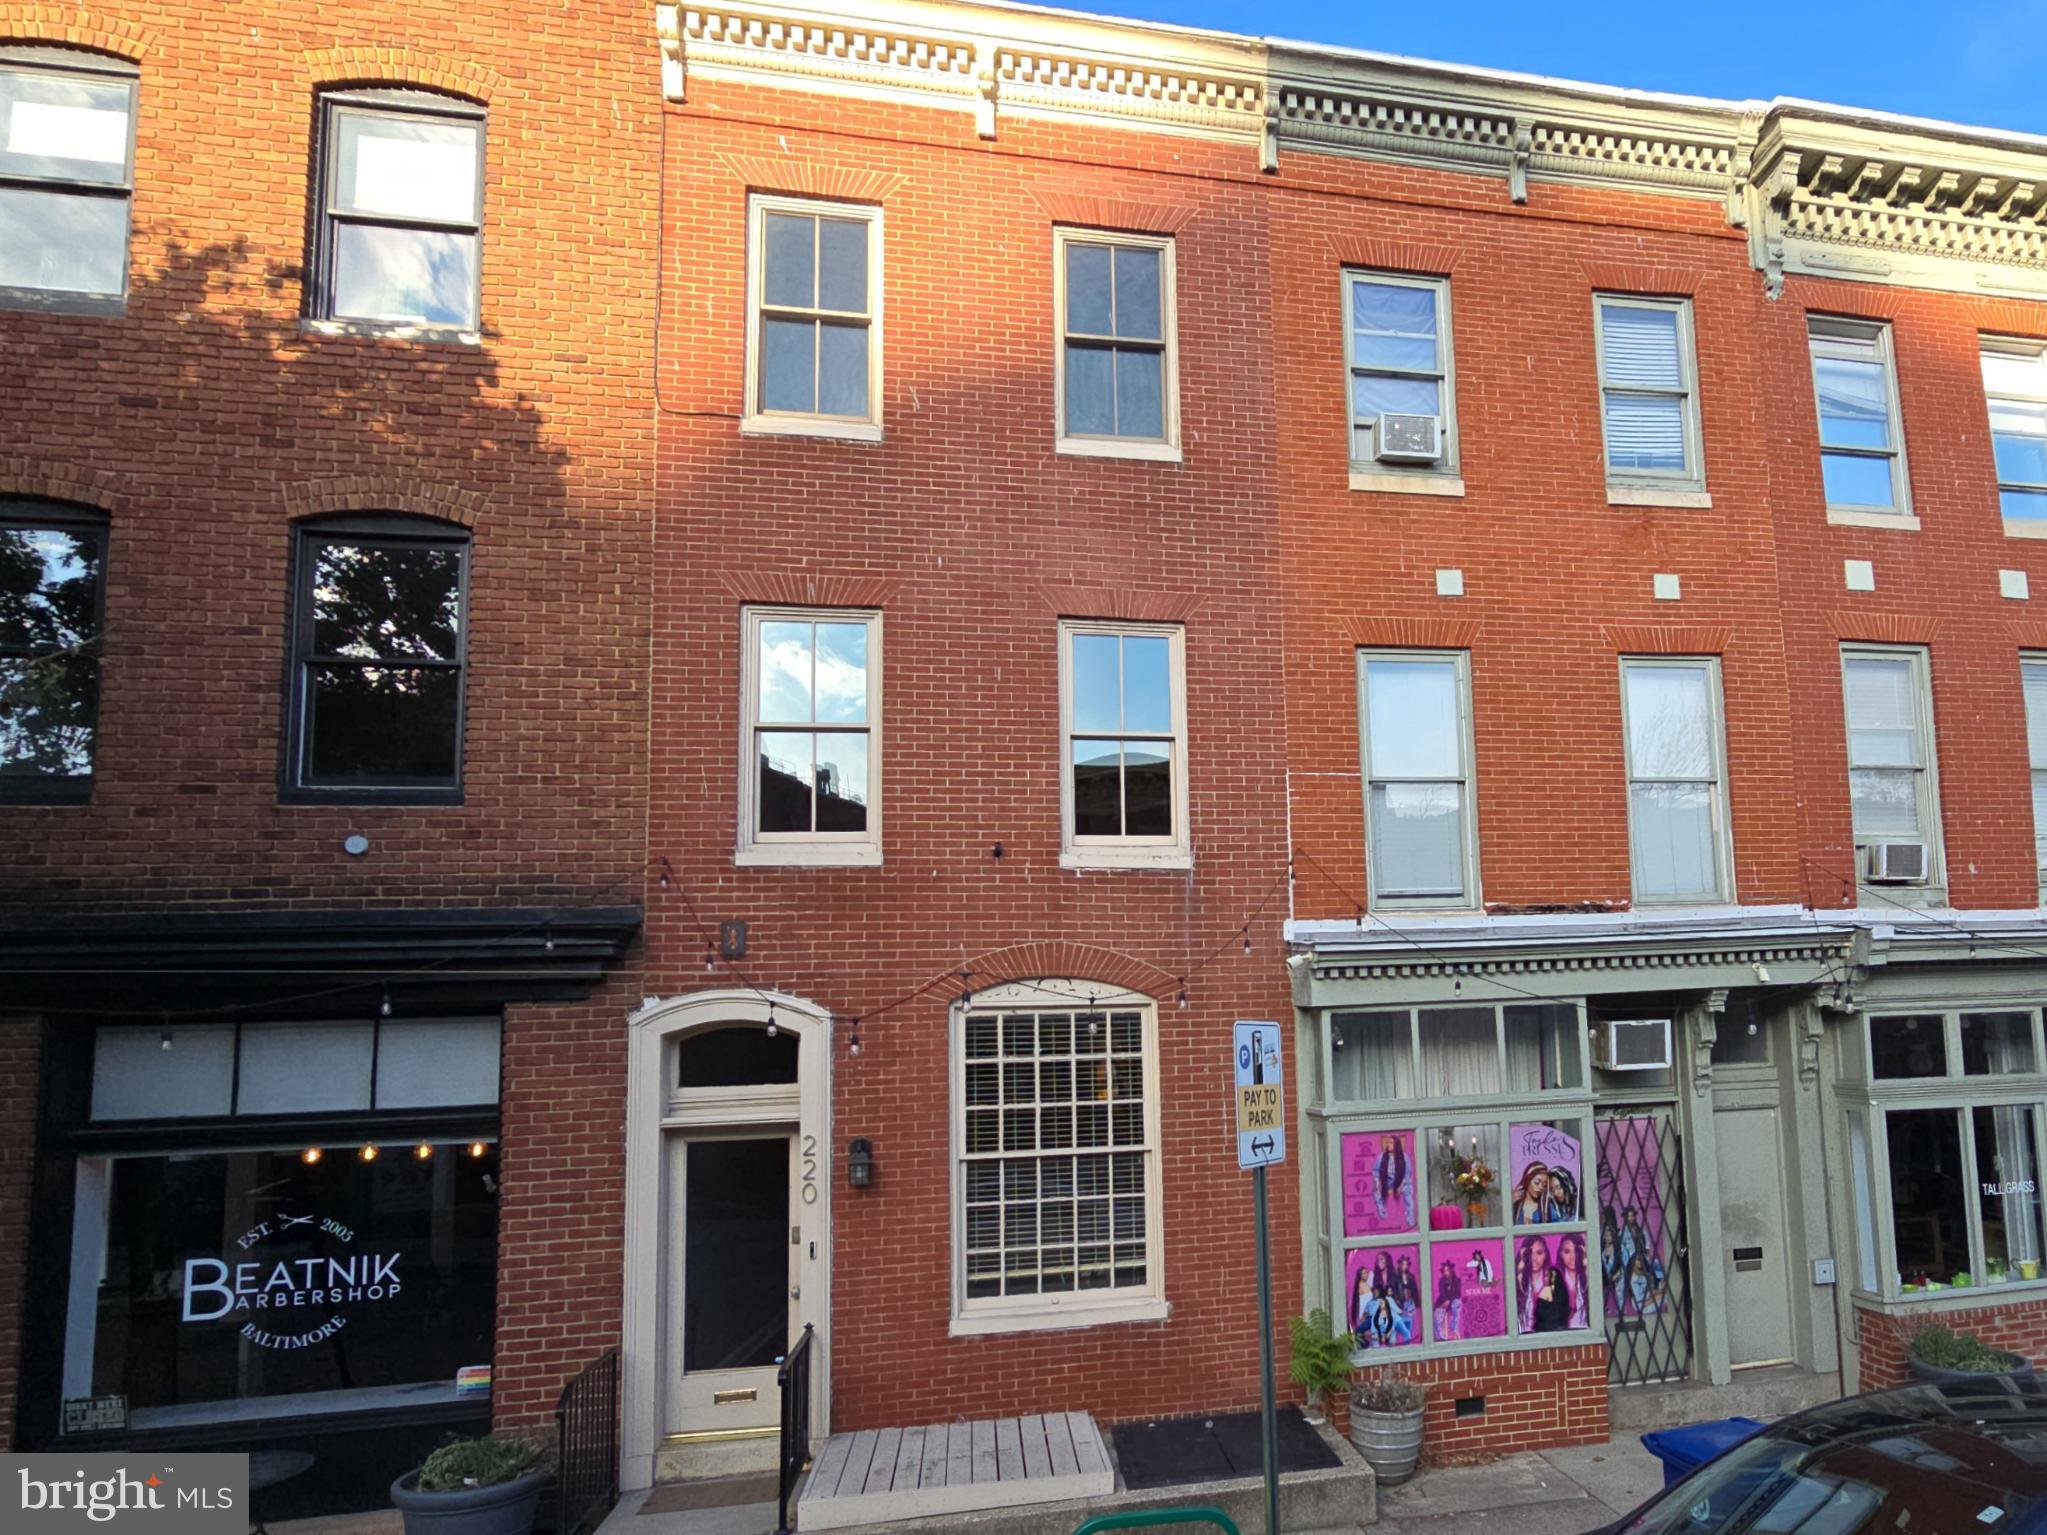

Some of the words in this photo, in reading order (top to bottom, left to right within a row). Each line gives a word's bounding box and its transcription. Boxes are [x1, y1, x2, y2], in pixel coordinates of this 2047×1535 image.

[1244, 1089, 1262, 1107] PAY
[1263, 1088, 1276, 1105] TO
[1248, 1109, 1274, 1127] PARK
[802, 1134, 818, 1205] 220
[319, 1217, 355, 1243] 2005
[182, 1252, 401, 1322] BEATNIK
[240, 1314, 347, 1349] BALTIMORE
